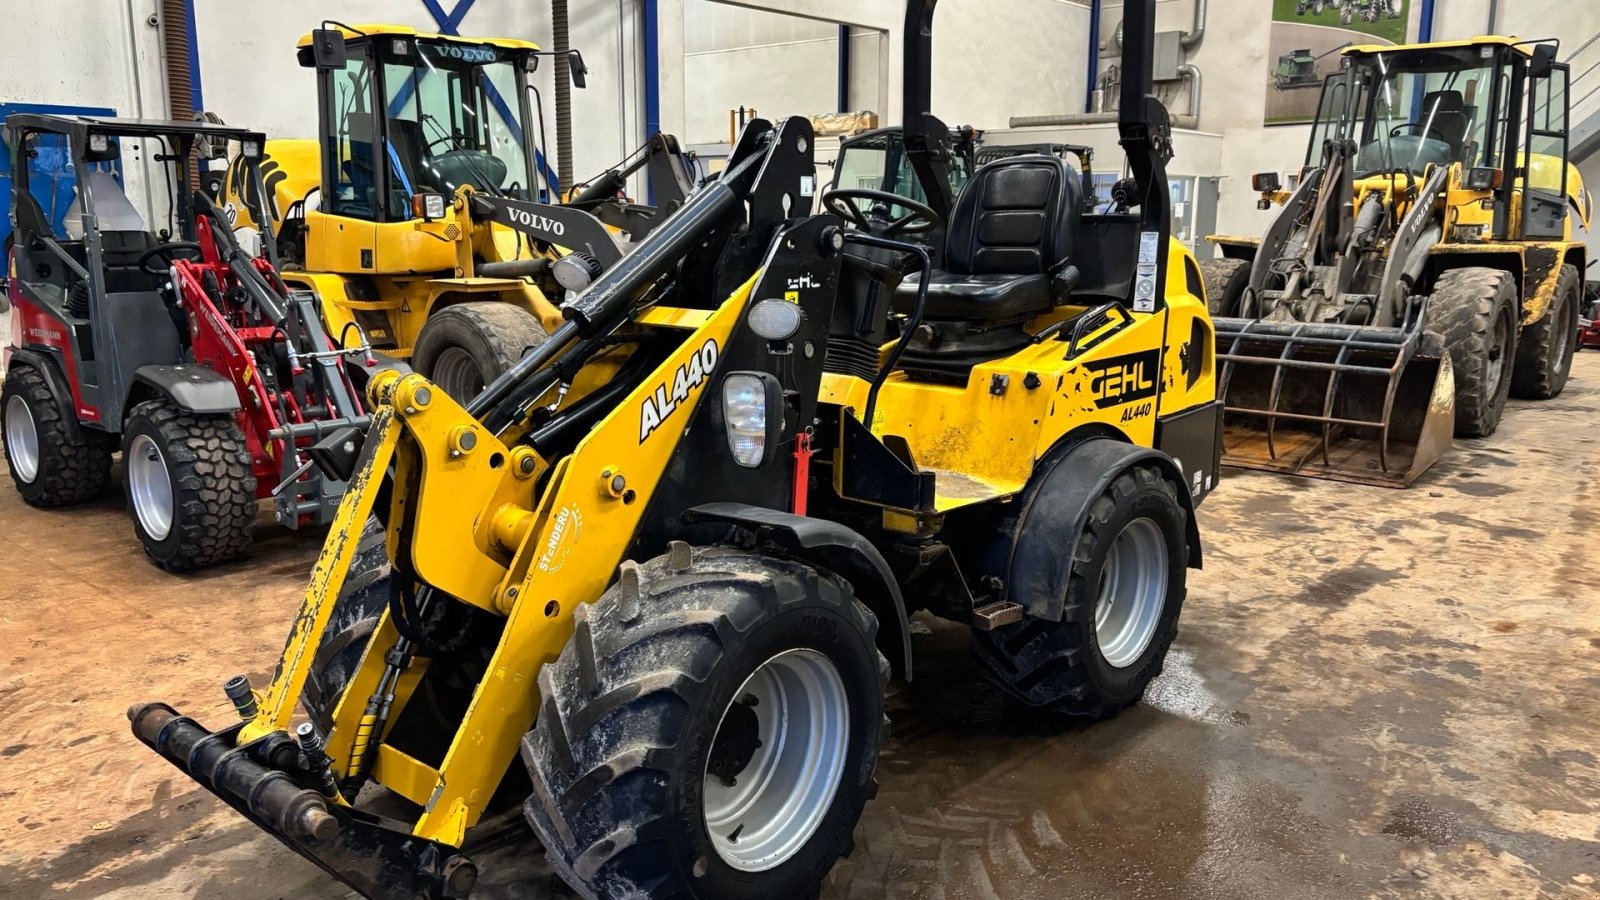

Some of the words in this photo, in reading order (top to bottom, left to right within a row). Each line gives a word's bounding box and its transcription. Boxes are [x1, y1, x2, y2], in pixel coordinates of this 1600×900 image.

[433, 44, 496, 62] VOLVO
[506, 206, 565, 236] VOLVO
[1410, 192, 1435, 233] VOLVO
[200, 301, 238, 357] WEIDEMANN
[639, 337, 719, 446] AL440
[1089, 360, 1153, 399] GEHL
[1120, 402, 1152, 423] AL440
[539, 506, 571, 572] STENDERU
